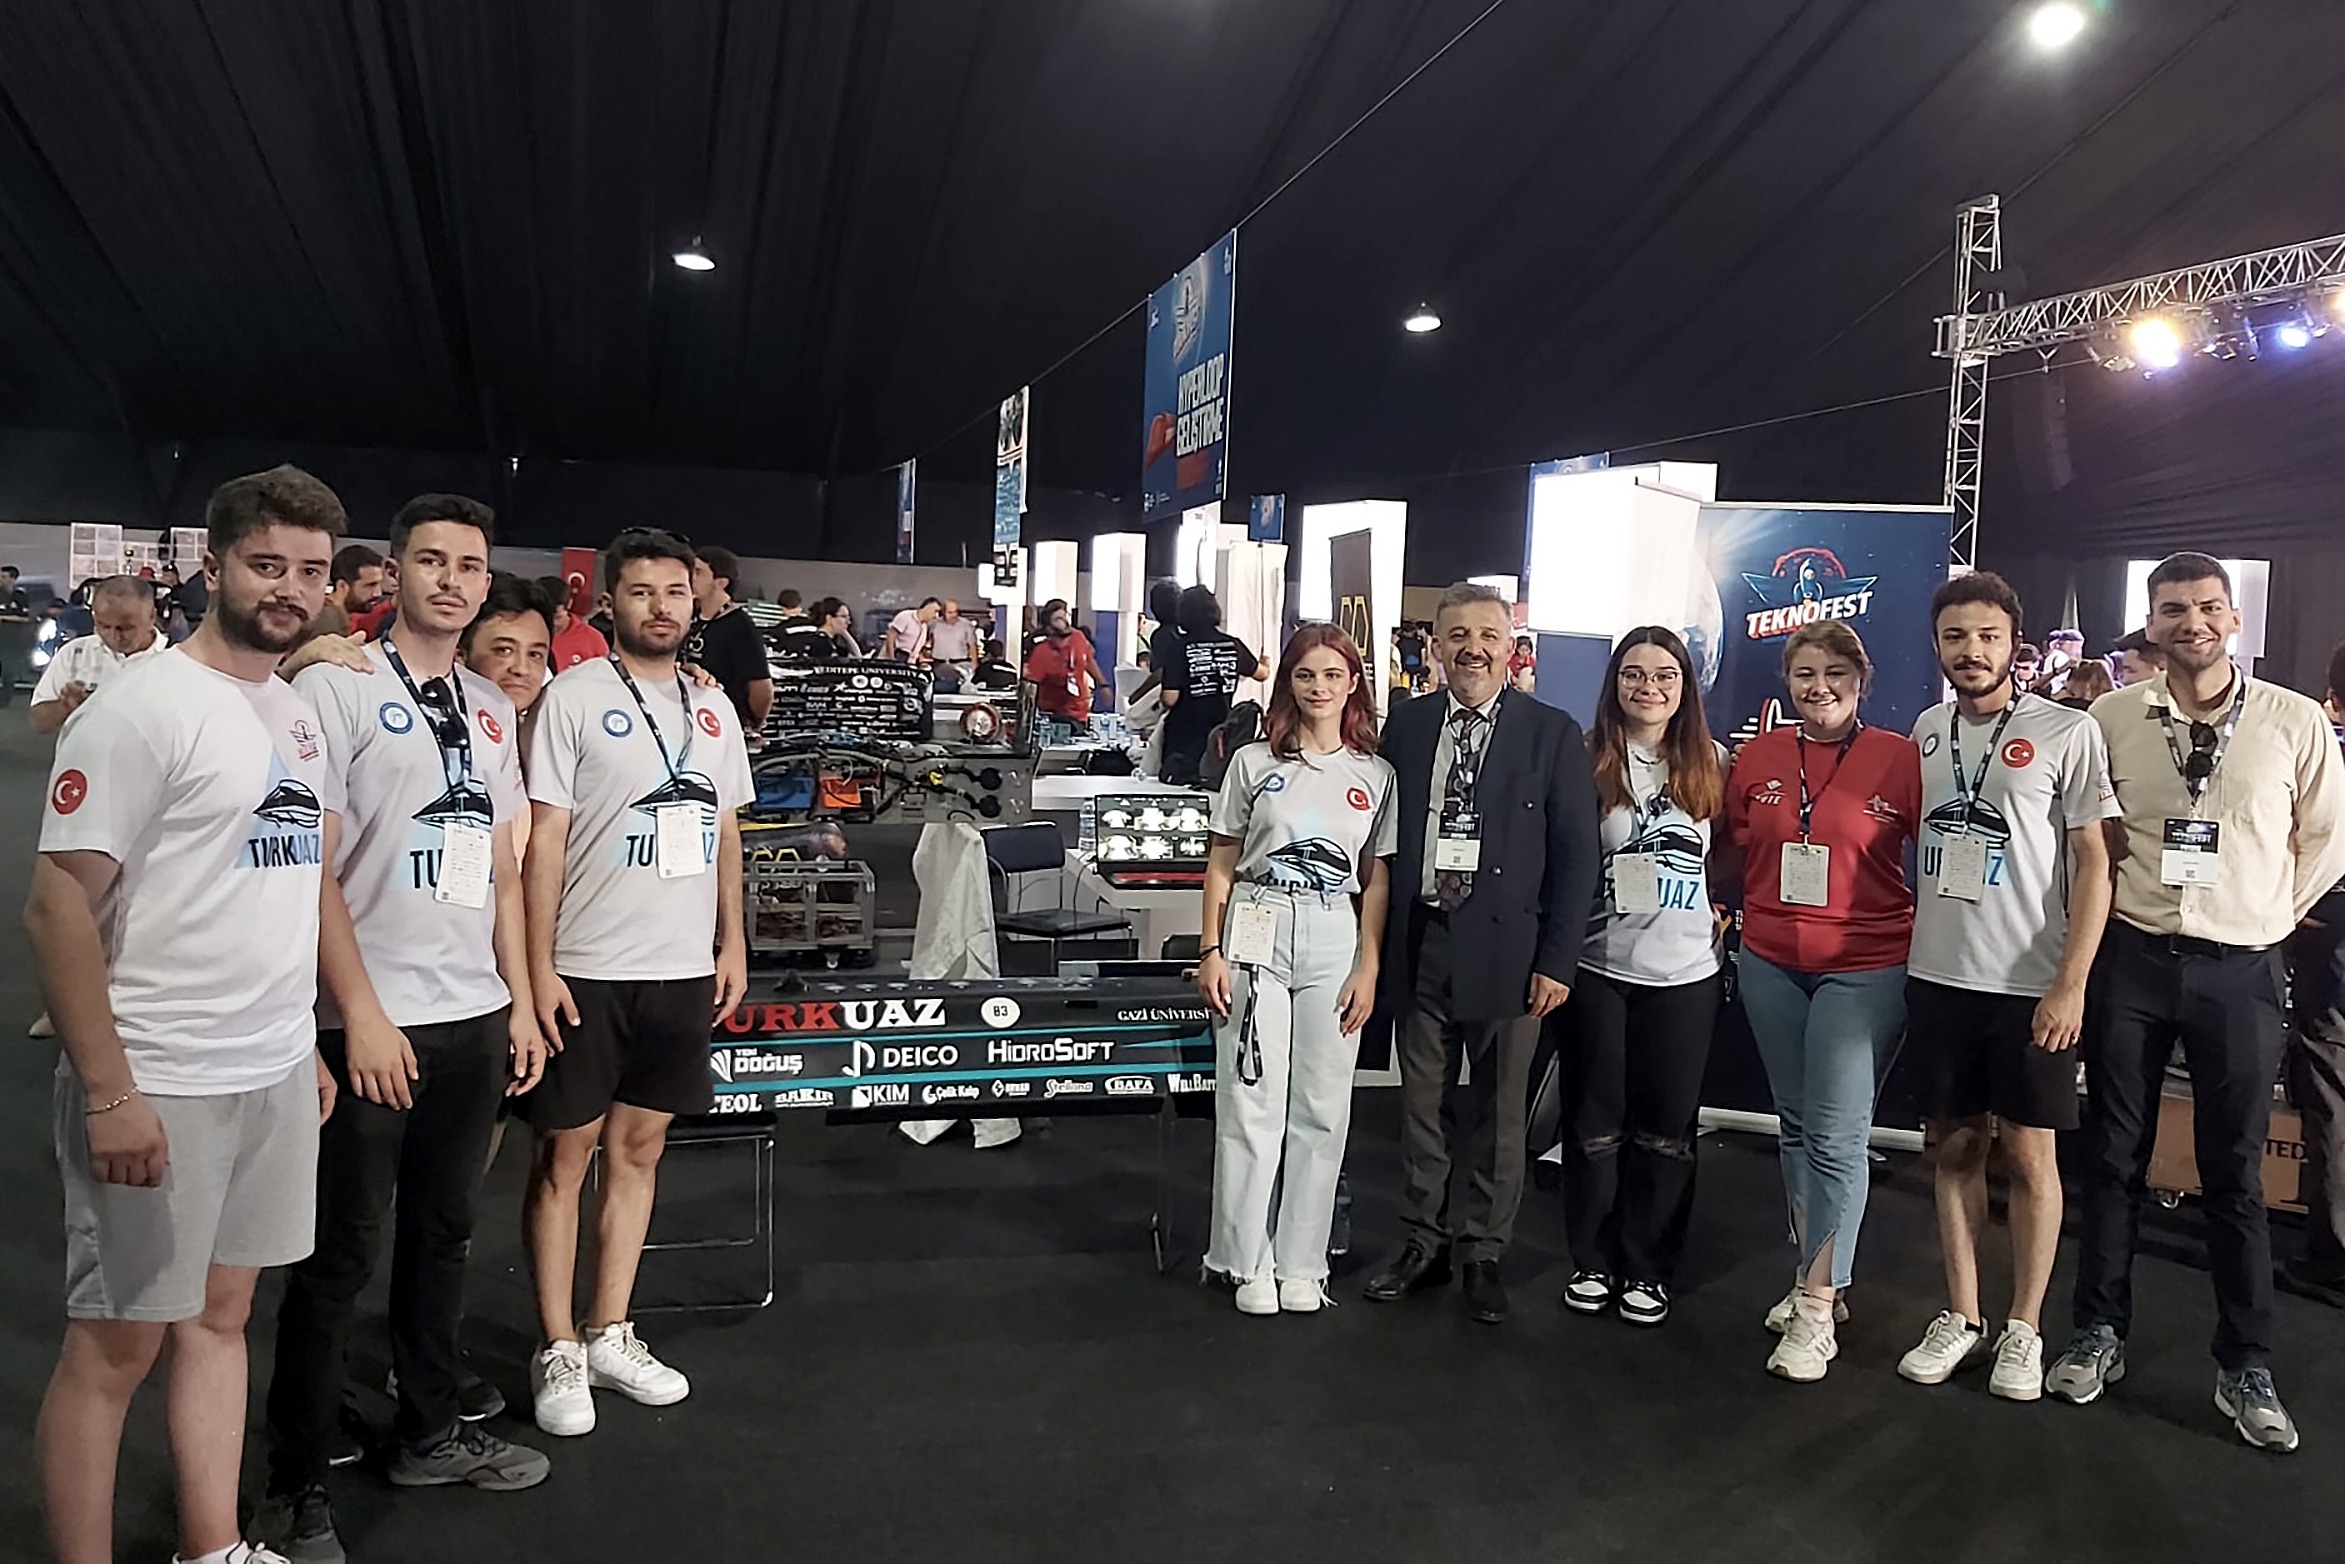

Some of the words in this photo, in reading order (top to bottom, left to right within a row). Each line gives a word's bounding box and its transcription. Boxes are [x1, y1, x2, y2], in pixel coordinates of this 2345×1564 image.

[1746, 591, 1873, 638] TEKNOFEST
[248, 834, 320, 868] TURKUAZ
[724, 998, 946, 1032] URKUAZ
[734, 1053, 803, 1075] DOĞUŞ
[883, 1045, 958, 1068] DEICO
